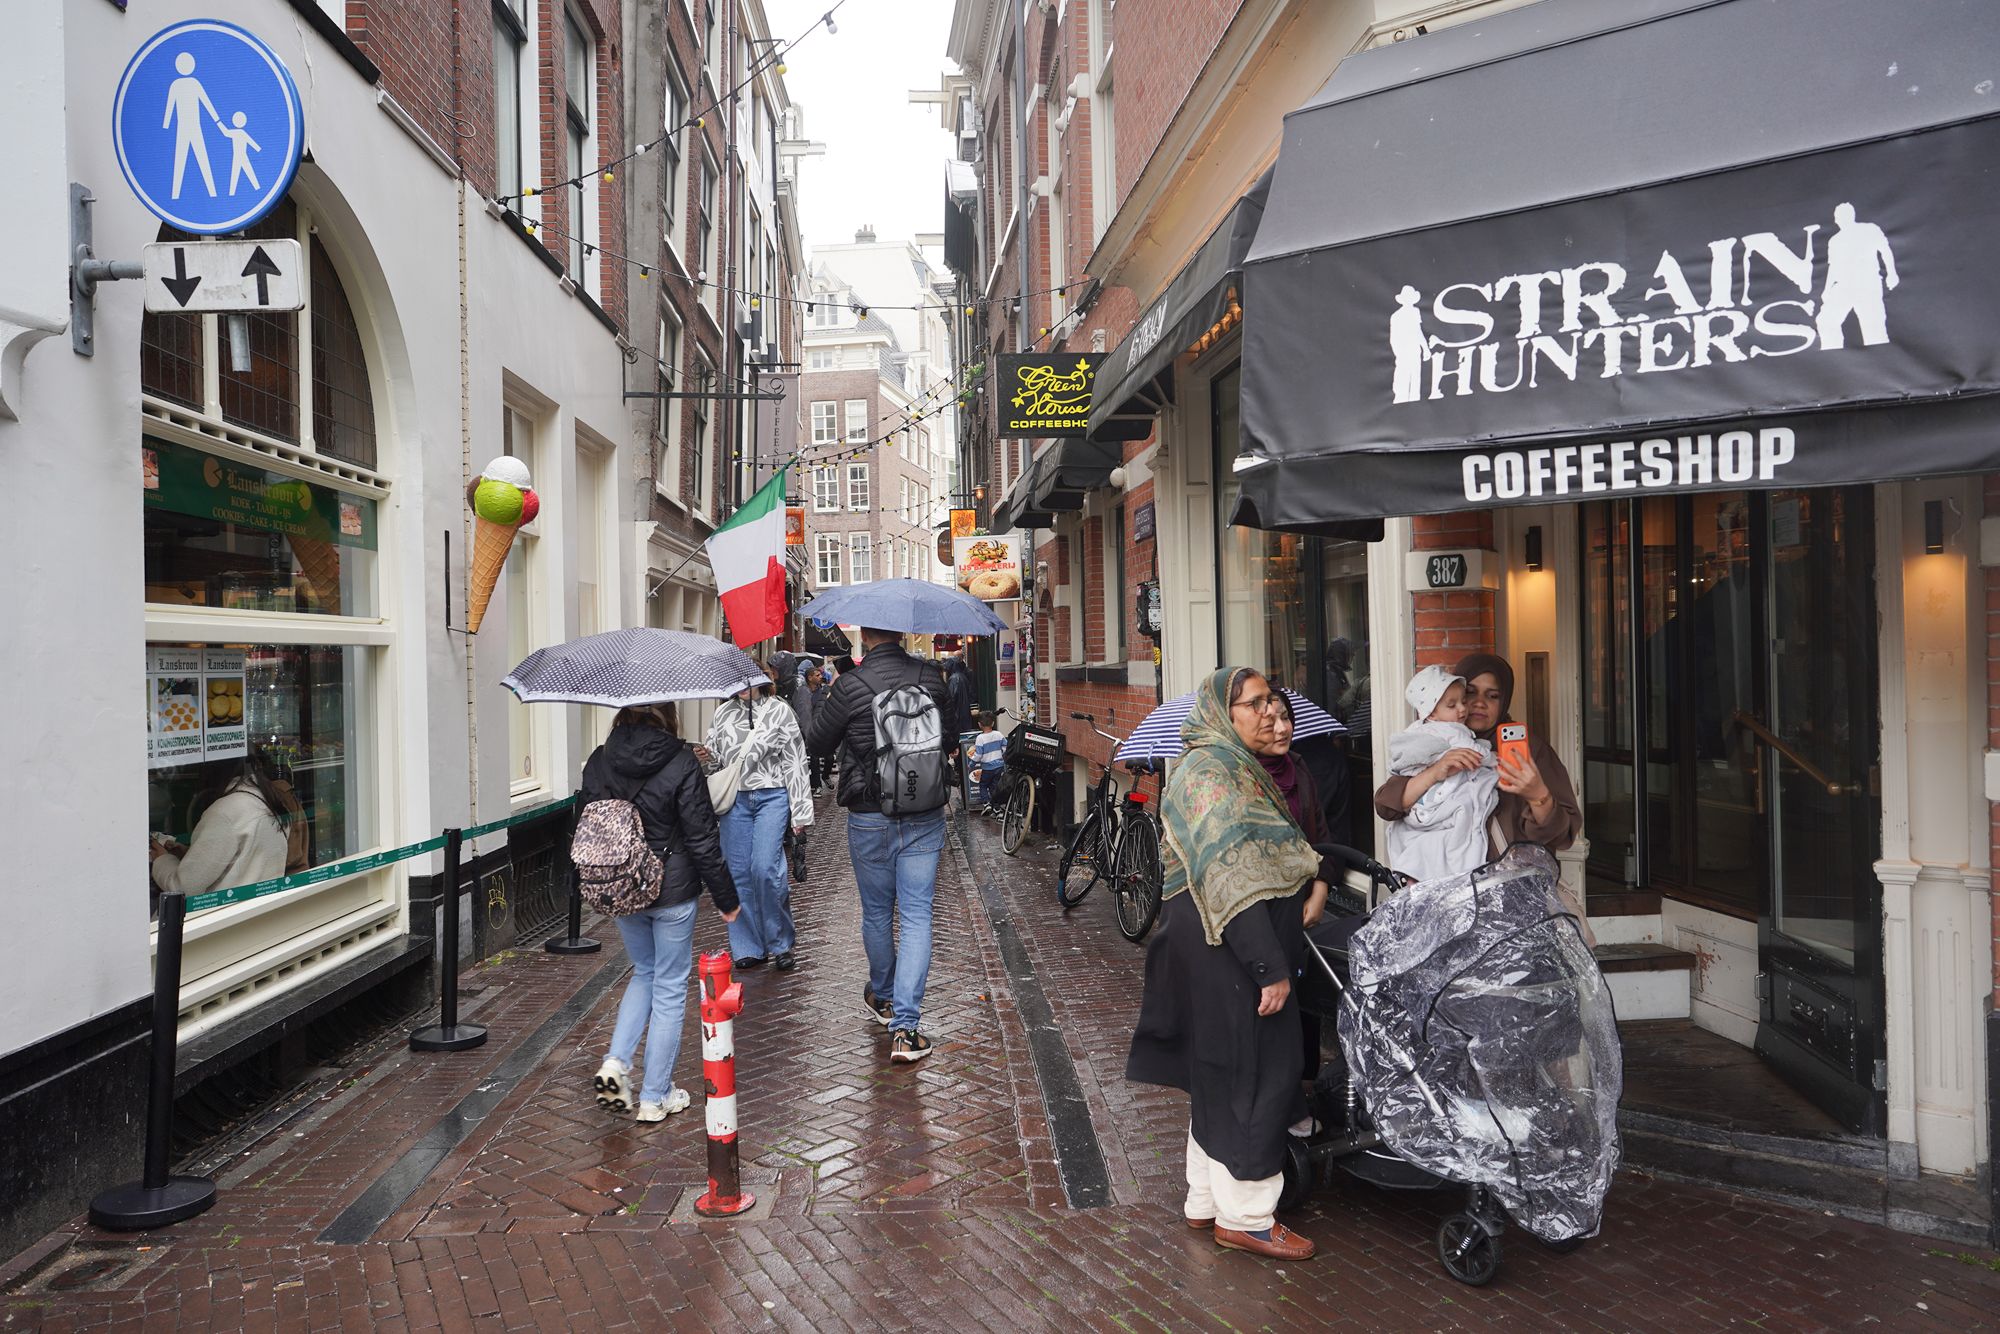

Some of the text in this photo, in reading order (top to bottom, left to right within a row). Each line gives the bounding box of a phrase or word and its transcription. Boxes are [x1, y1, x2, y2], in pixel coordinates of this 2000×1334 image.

[1428, 223, 1821, 349] STRAIN
[1428, 300, 1818, 401] HUNTERS
[1017, 364, 1088, 392] Green
[1025, 391, 1092, 416] House
[768, 377, 785, 468] COFFEESH
[1010, 419, 1089, 429] COFFEESHO
[1462, 426, 1796, 502] COFFEESHOP
[227, 468, 294, 503] Lanskroon
[231, 496, 250, 510] KOEK
[256, 501, 279, 515] TAART
[212, 507, 307, 535] COOKIES CAKE ICE CREAM
[959, 564, 972, 572] IJS
[1432, 556, 1459, 584] 387
[158, 658, 199, 671] Lanskroon
[207, 658, 242, 671] Lanskroon
[904, 769, 919, 801] Jeep
